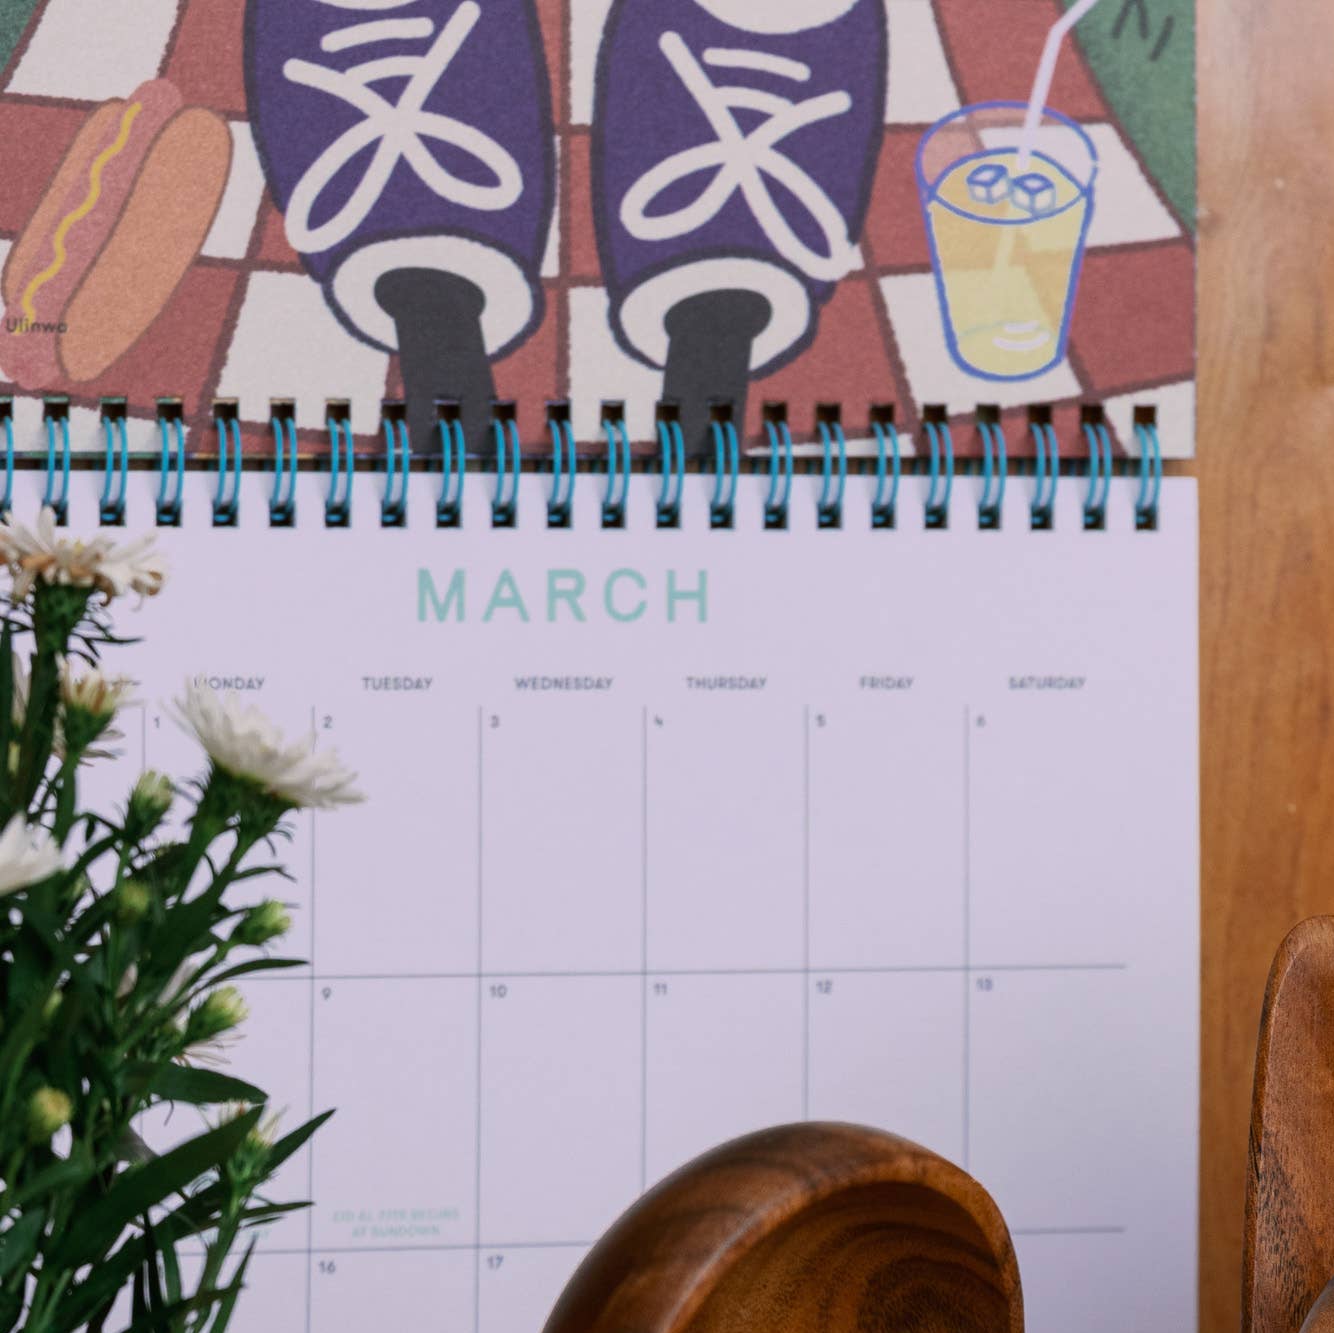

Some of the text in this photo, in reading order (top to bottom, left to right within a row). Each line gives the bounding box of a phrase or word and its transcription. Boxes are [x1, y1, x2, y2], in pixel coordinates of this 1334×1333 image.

[416, 567, 709, 624] MARCH
[362, 676, 434, 691] TUESDAY
[513, 676, 614, 691] WEDNESDAY
[686, 675, 768, 691] THURSDAY
[859, 675, 914, 691] FRIDAY
[1008, 675, 1087, 691] SATURDAY
[323, 715, 334, 729] 2
[489, 984, 508, 999] 10
[652, 982, 668, 997] 11
[318, 1254, 505, 1274] 16 17
